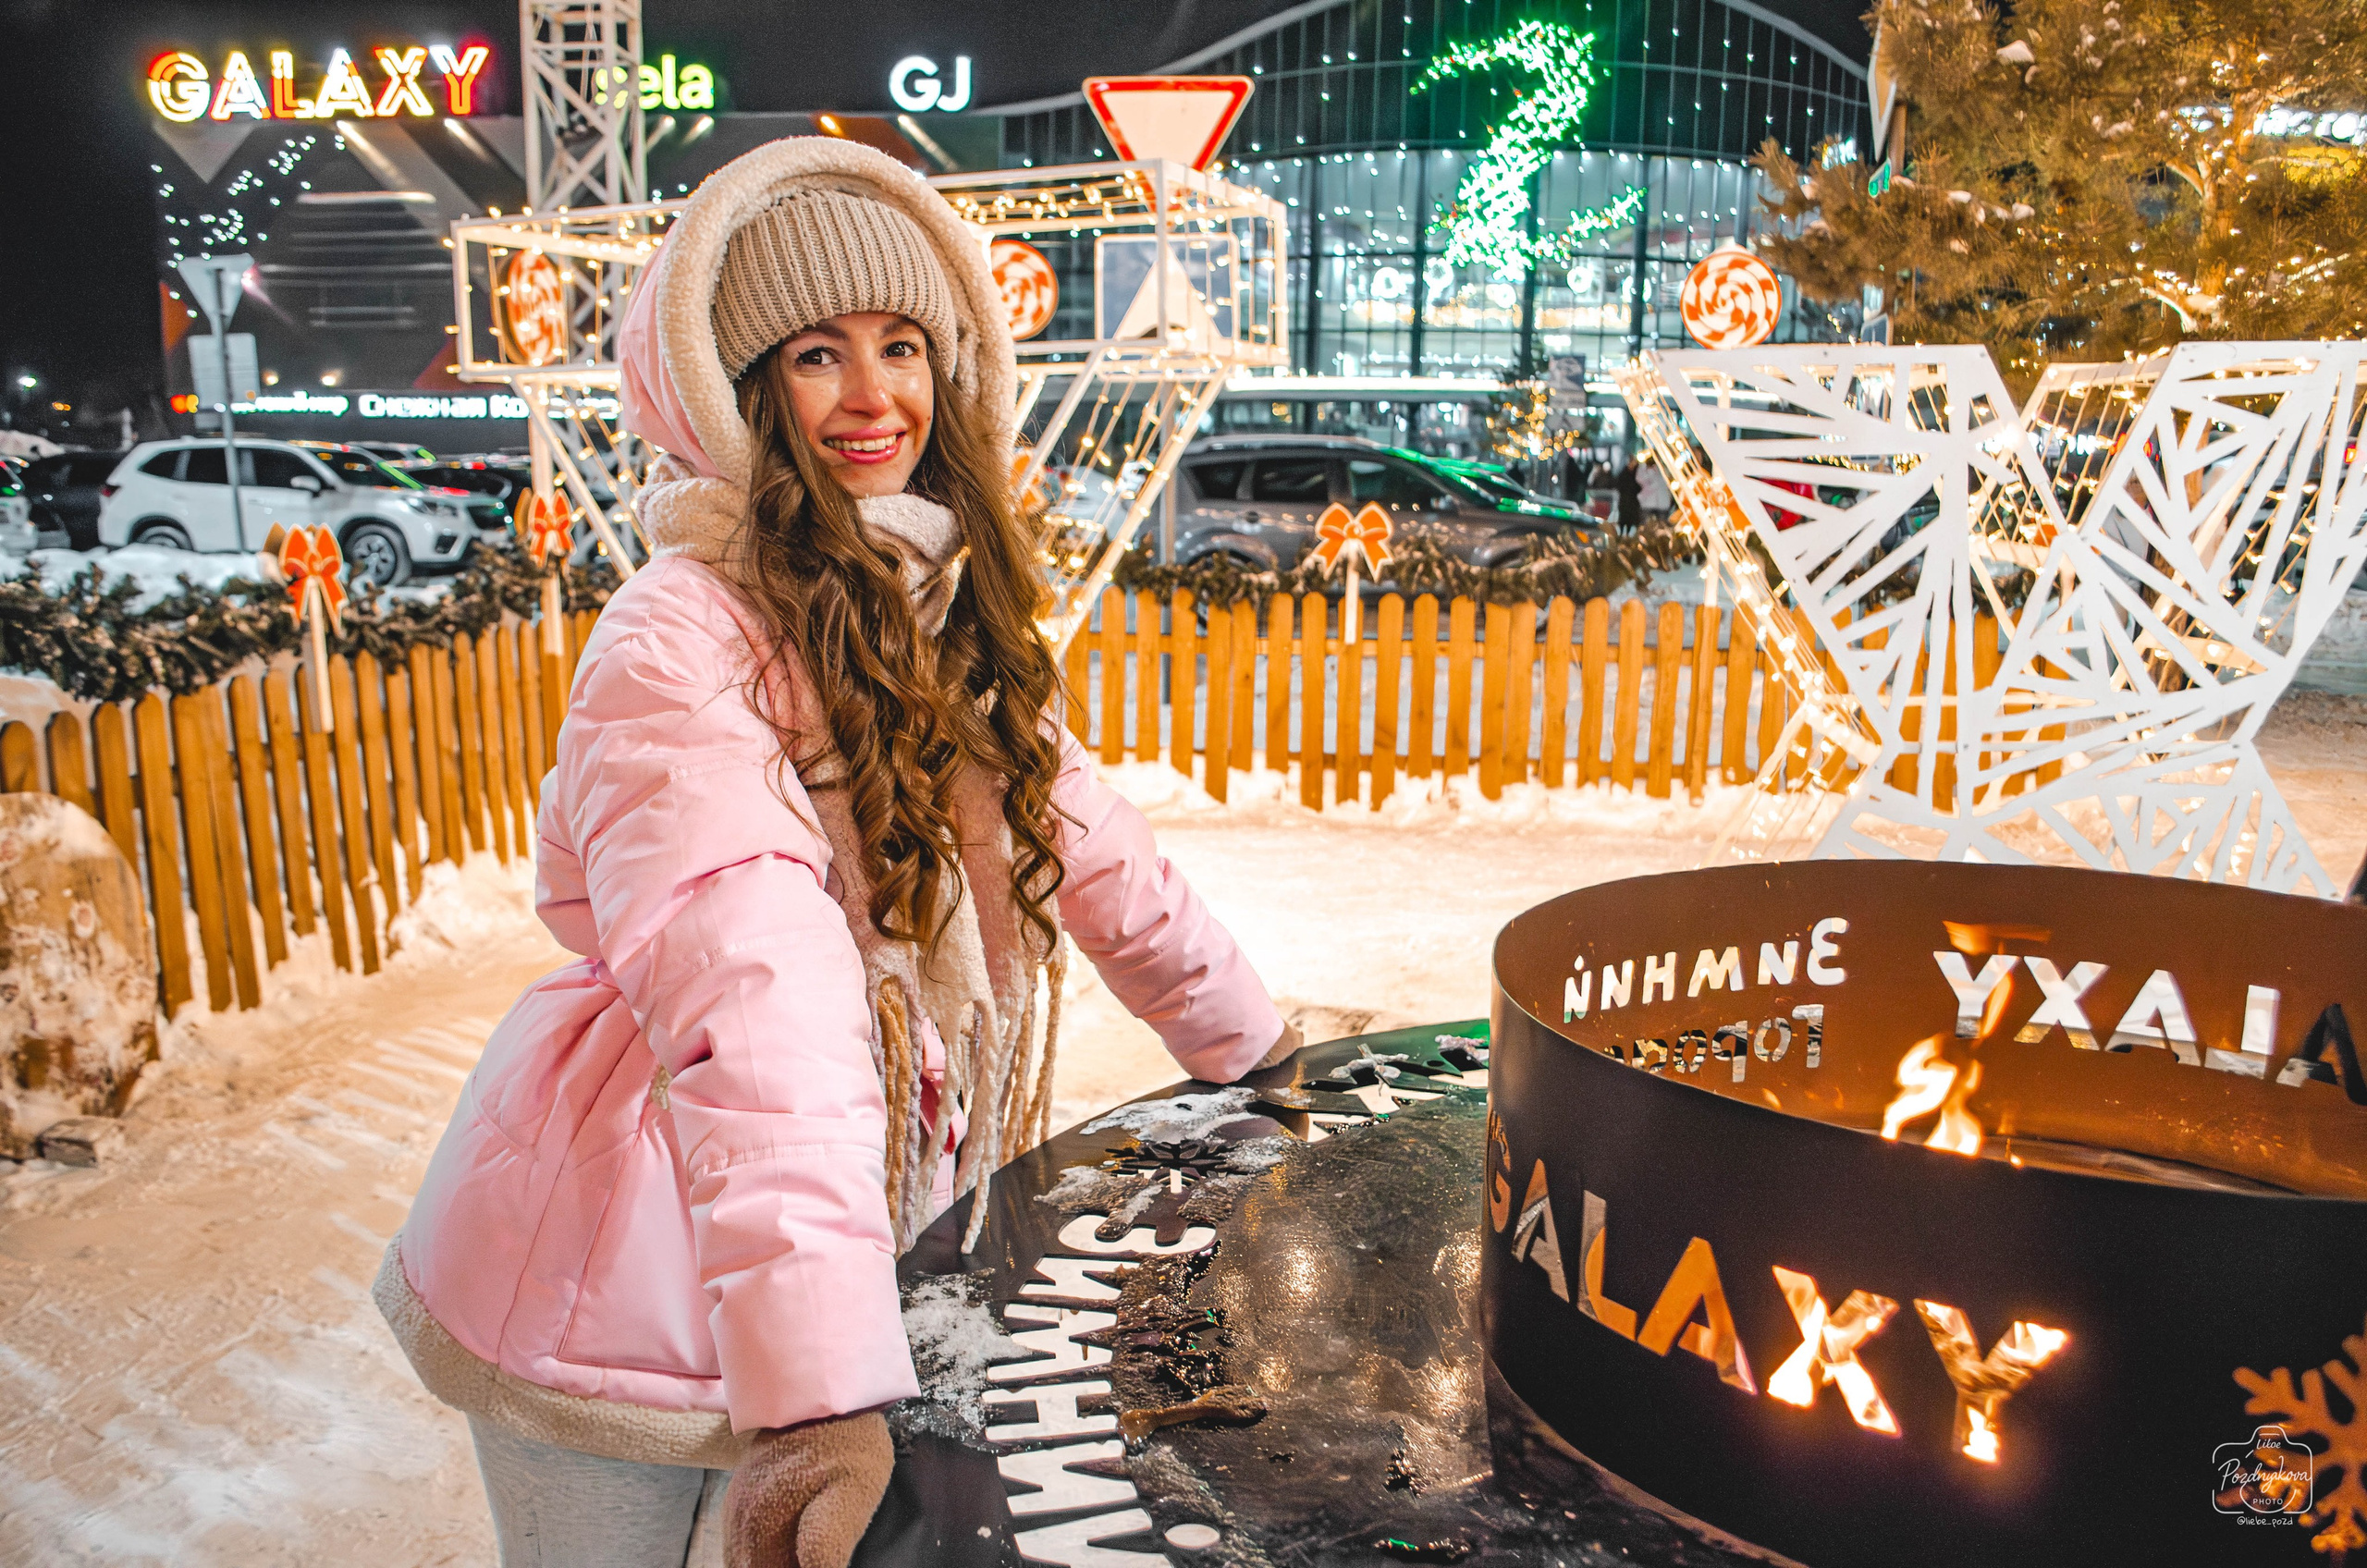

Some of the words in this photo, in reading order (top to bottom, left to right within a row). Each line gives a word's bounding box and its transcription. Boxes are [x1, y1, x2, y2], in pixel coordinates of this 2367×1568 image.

[148, 46, 490, 122] GALAXY
[595, 54, 715, 110] sela
[889, 55, 972, 112] GJ
[1489, 1109, 2073, 1464] GALAXY
